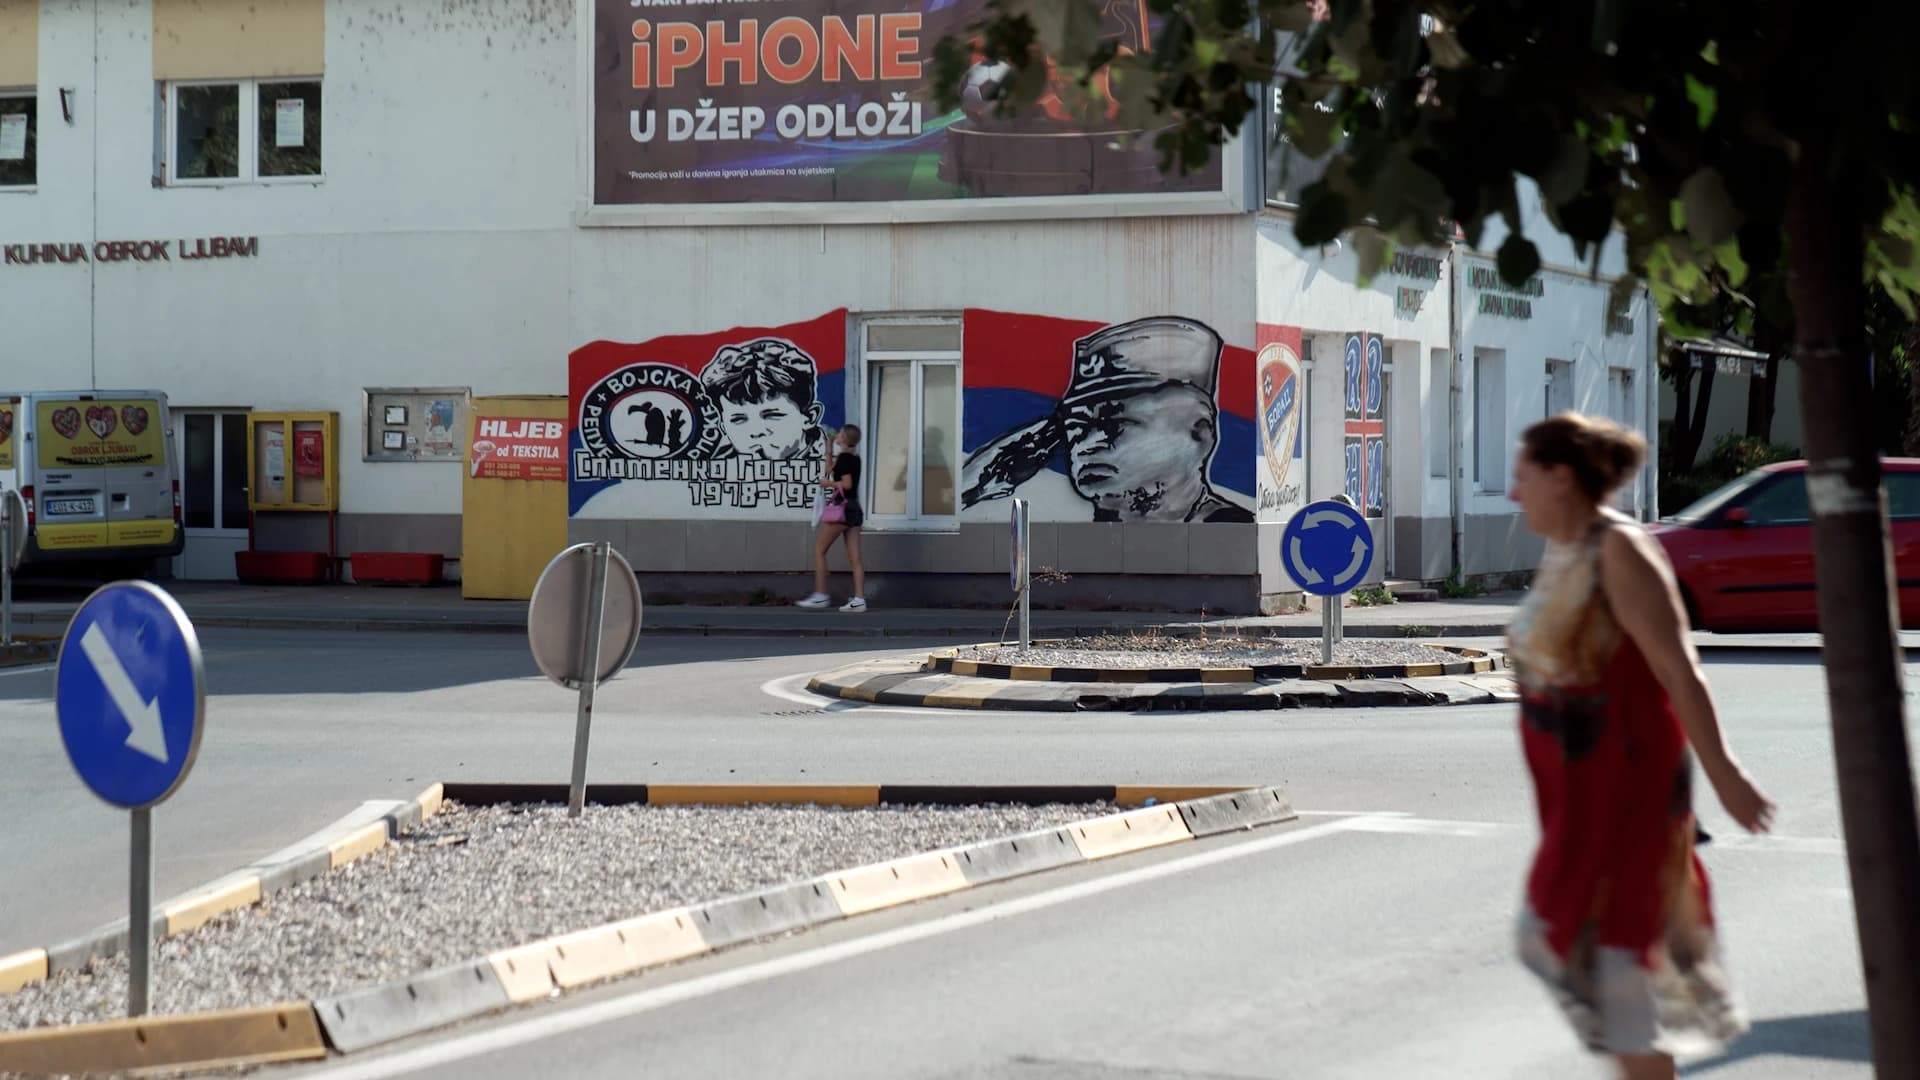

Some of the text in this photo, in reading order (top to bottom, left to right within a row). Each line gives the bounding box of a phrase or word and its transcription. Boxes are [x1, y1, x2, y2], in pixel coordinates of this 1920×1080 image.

[632, 12, 922, 89] iPHONE
[630, 91, 922, 142] U DŽEP ODLOŽI
[692, 168, 721, 178] danima
[786, 168, 797, 176] na
[4, 236, 259, 265] KUHINJA OBROK LJUBAVI
[480, 420, 562, 439] HLJEB
[497, 445, 559, 458] od TEKSTILA
